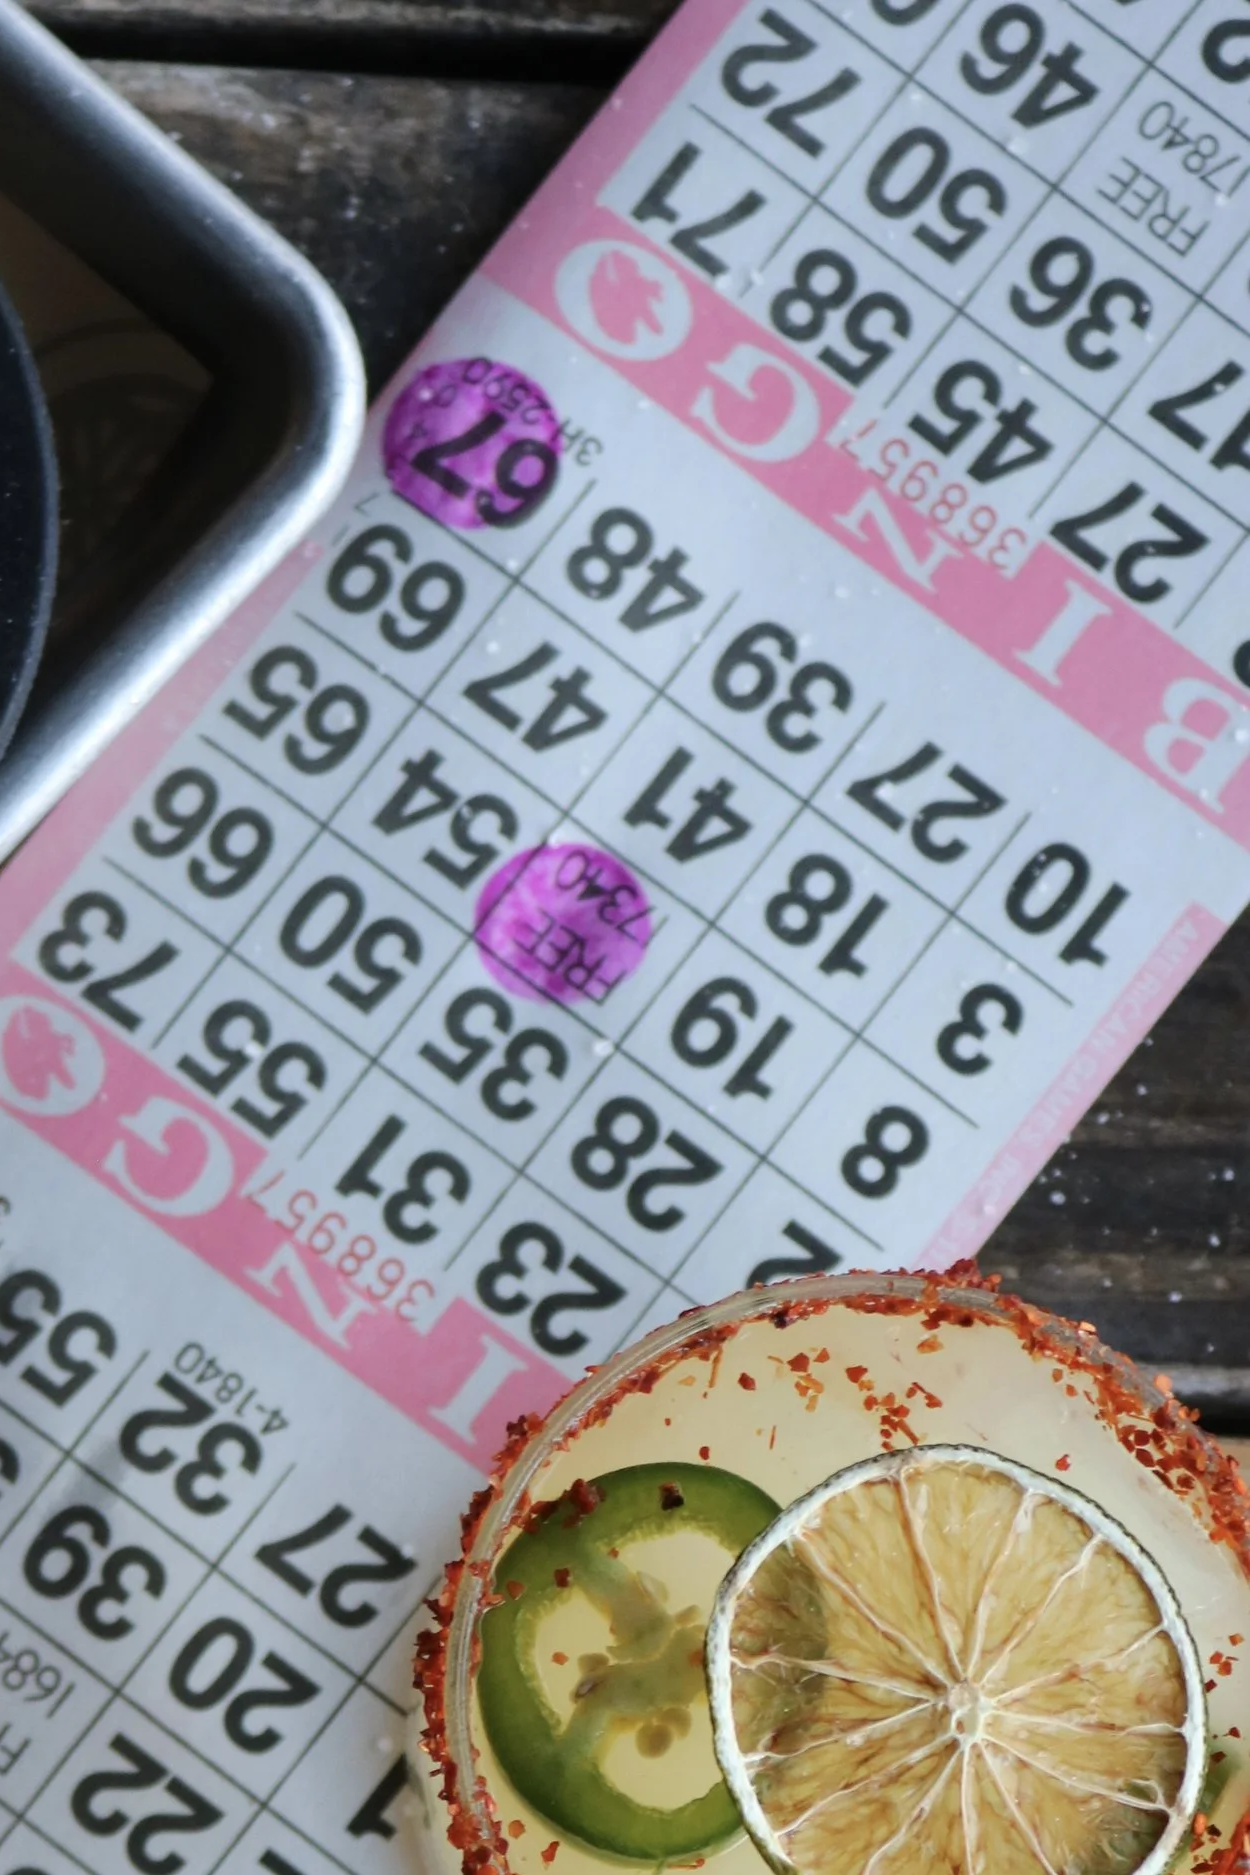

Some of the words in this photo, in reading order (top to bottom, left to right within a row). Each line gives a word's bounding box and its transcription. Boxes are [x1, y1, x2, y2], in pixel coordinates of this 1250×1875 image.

[720, 6, 860, 158] 72
[959, 1, 1099, 128] 46
[630, 139, 765, 278] 71
[865, 125, 1006, 264] 50
[1095, 154, 1209, 258] FREE
[769, 247, 911, 387] 58
[1008, 234, 1151, 371] 36
[410, 409, 554, 522] 67
[907, 358, 1052, 484] 45
[837, 408, 1031, 572] 368957
[1048, 480, 1209, 604] 27
[325, 521, 464, 652] 69
[565, 505, 703, 632] 48
[222, 643, 369, 775] 65
[461, 640, 607, 752] 47
[711, 619, 853, 753] 39
[131, 765, 274, 899] 66
[371, 747, 518, 890] 54
[622, 744, 752, 864] 41
[845, 740, 1006, 863] 27
[37, 889, 178, 1032] 73
[278, 873, 422, 1014] 50
[509, 901, 632, 1012] FREE
[764, 851, 888, 977] 18
[1004, 840, 1128, 966] 10
[176, 998, 326, 1139] 55
[418, 986, 569, 1122] 35
[669, 975, 793, 1099] 19
[935, 981, 1023, 1076] 3
[334, 1113, 471, 1245] 31
[570, 1094, 722, 1232] 28
[840, 1103, 929, 1199] 8
[243, 1158, 440, 1325] 368957
[475, 1220, 626, 1357] 23
[116, 1370, 262, 1515] 32
[170, 1337, 293, 1442] 4-1840
[23, 1503, 163, 1639] 39
[254, 1502, 419, 1629] 27
[168, 1615, 321, 1754] 20
